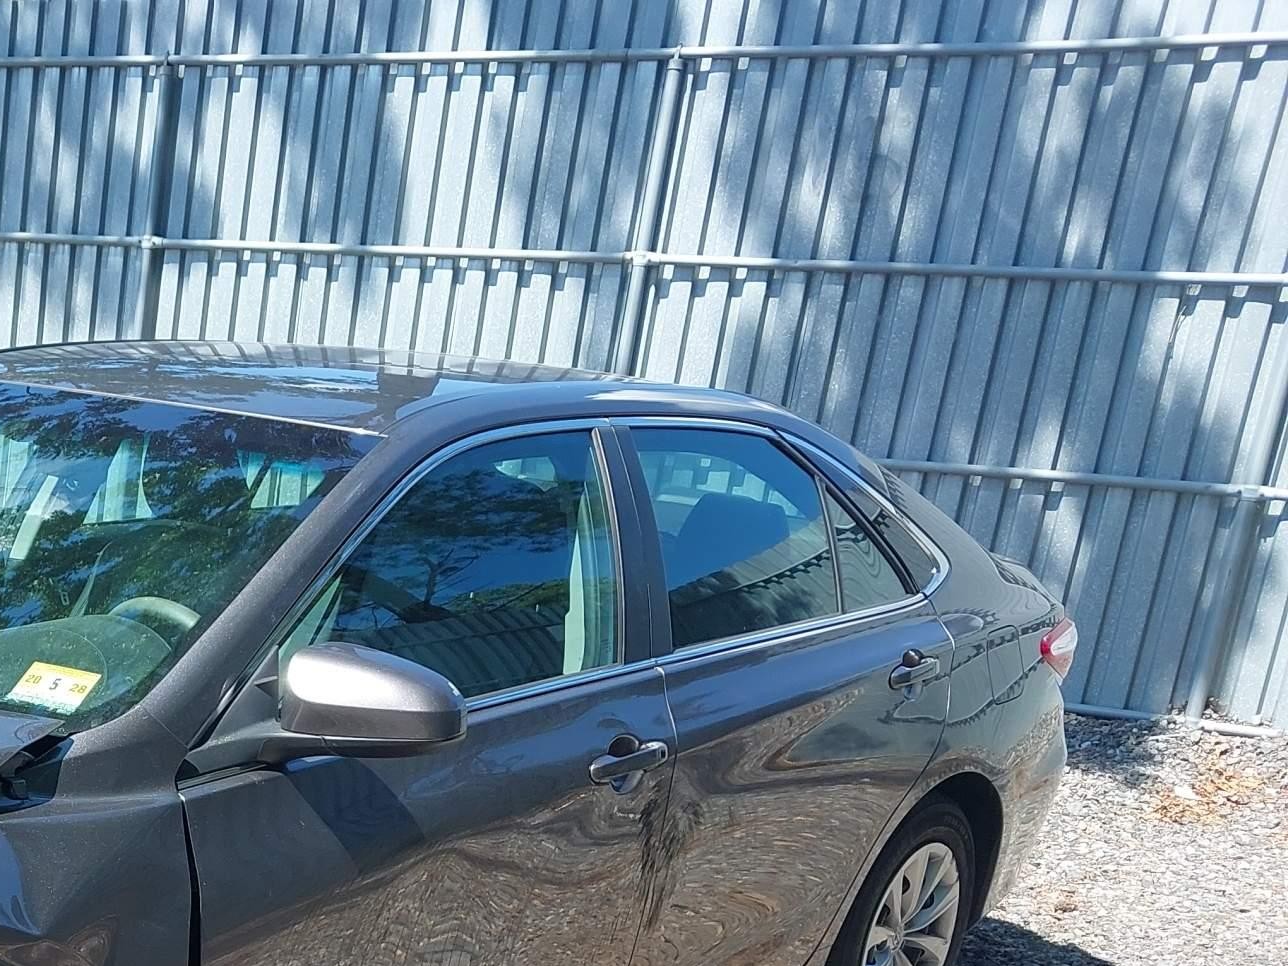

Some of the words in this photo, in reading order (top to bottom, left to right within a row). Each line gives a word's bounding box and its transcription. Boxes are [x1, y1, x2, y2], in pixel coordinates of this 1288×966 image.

[25, 674, 42, 685] 20
[49, 678, 62, 690] 5
[69, 683, 88, 694] 28
